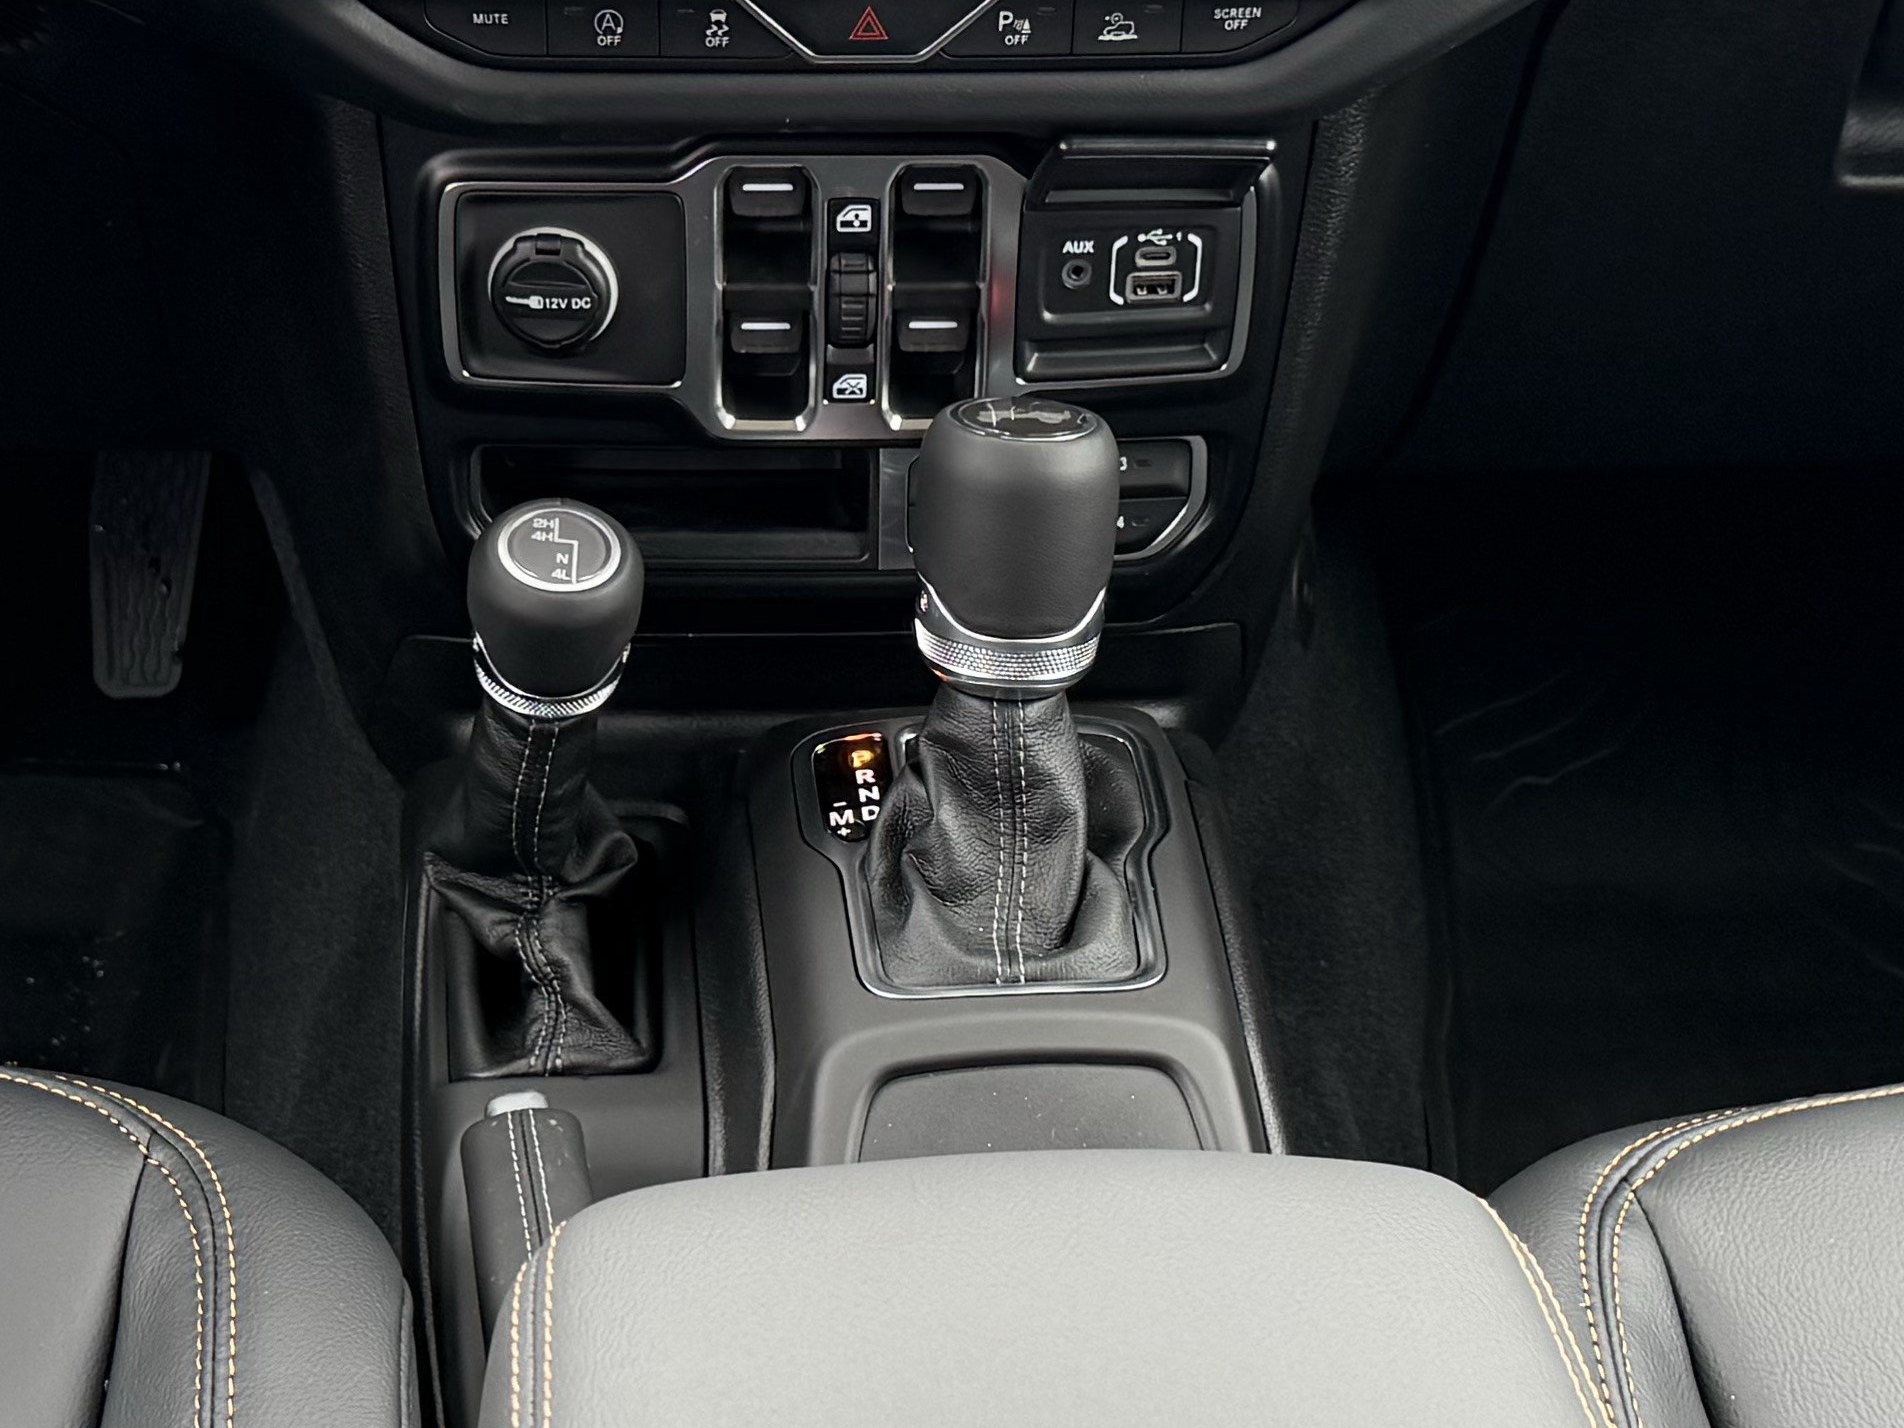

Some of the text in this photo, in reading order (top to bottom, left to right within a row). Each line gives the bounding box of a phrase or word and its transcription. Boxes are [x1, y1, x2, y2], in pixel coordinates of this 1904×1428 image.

[472, 13, 510, 26] MUTE
[1213, 6, 1263, 22] SCREEN
[998, 10, 1014, 33] P
[1223, 18, 1249, 32] OFF
[596, 34, 622, 47] OFF
[704, 36, 730, 49] OFF
[1004, 34, 1030, 47] OFF
[1061, 240, 1095, 255] AUX
[544, 296, 592, 311] 12V DC
[532, 517, 555, 530] 2H
[530, 530, 555, 543] 4H
[556, 552, 569, 565] N
[550, 568, 572, 581] 4L
[851, 749, 875, 768] P
[855, 768, 877, 785] R
[857, 785, 881, 803] N
[828, 808, 855, 827] M
[860, 804, 881, 822] D
